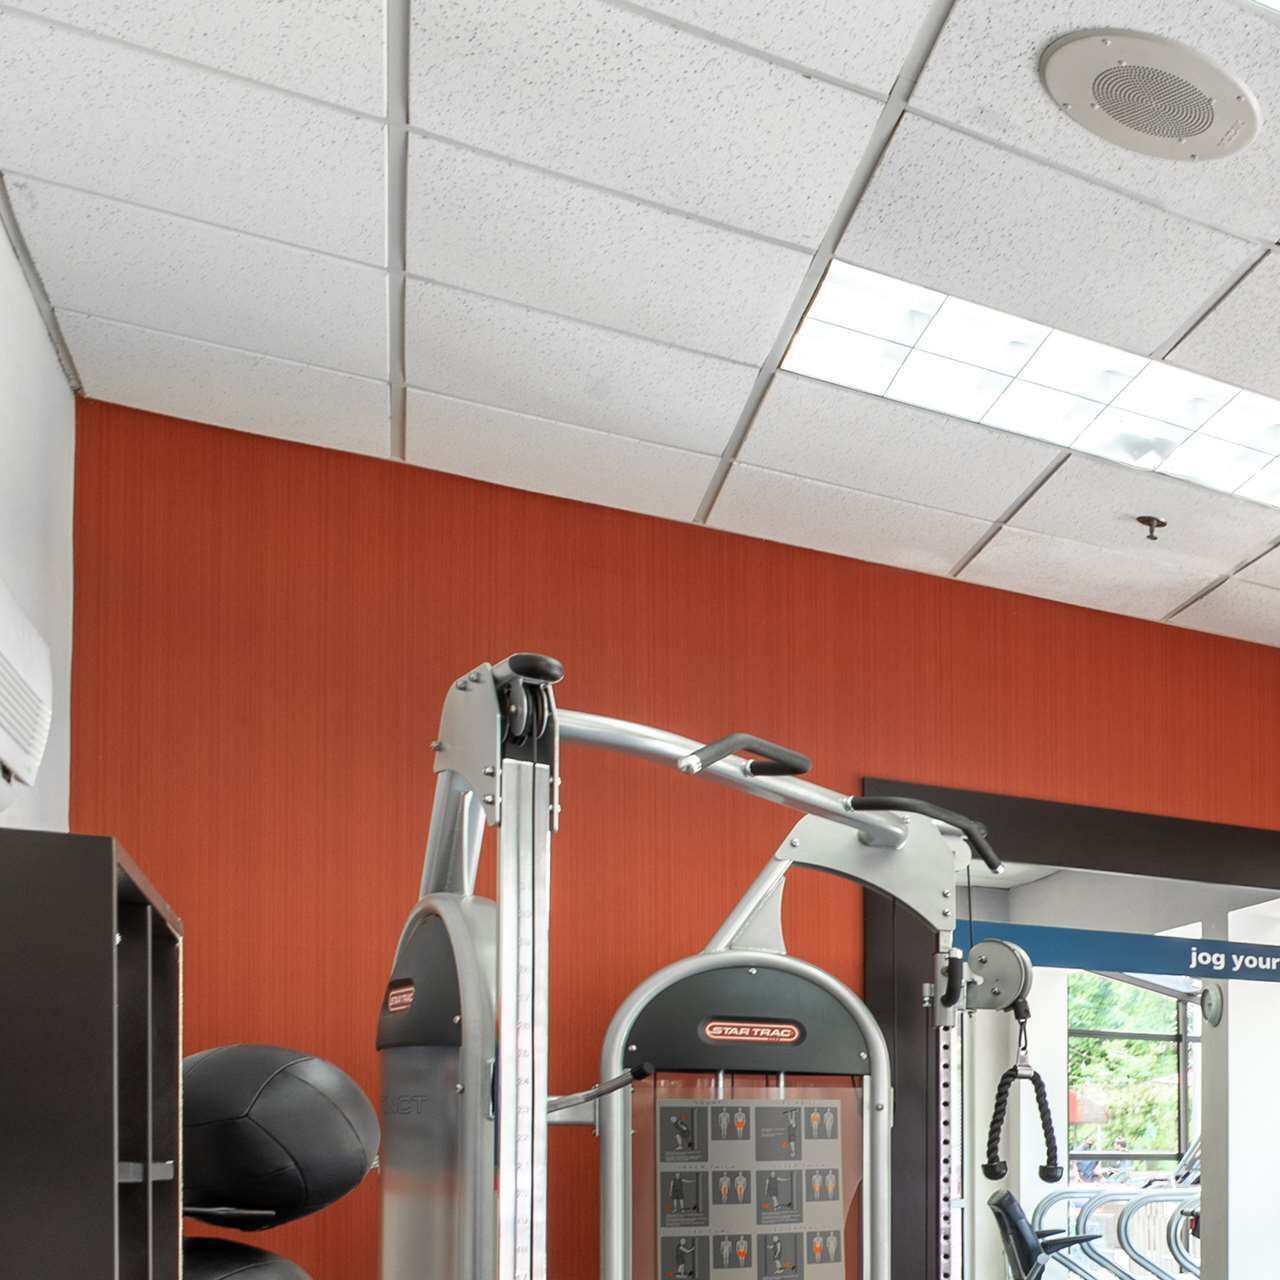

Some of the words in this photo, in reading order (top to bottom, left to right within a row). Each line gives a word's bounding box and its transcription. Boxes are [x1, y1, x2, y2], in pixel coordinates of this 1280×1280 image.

[1189, 947, 1226, 970] jog
[1231, 953, 1280, 972] your
[711, 1026, 750, 1036] STAR
[751, 1028, 792, 1037] TRAC
